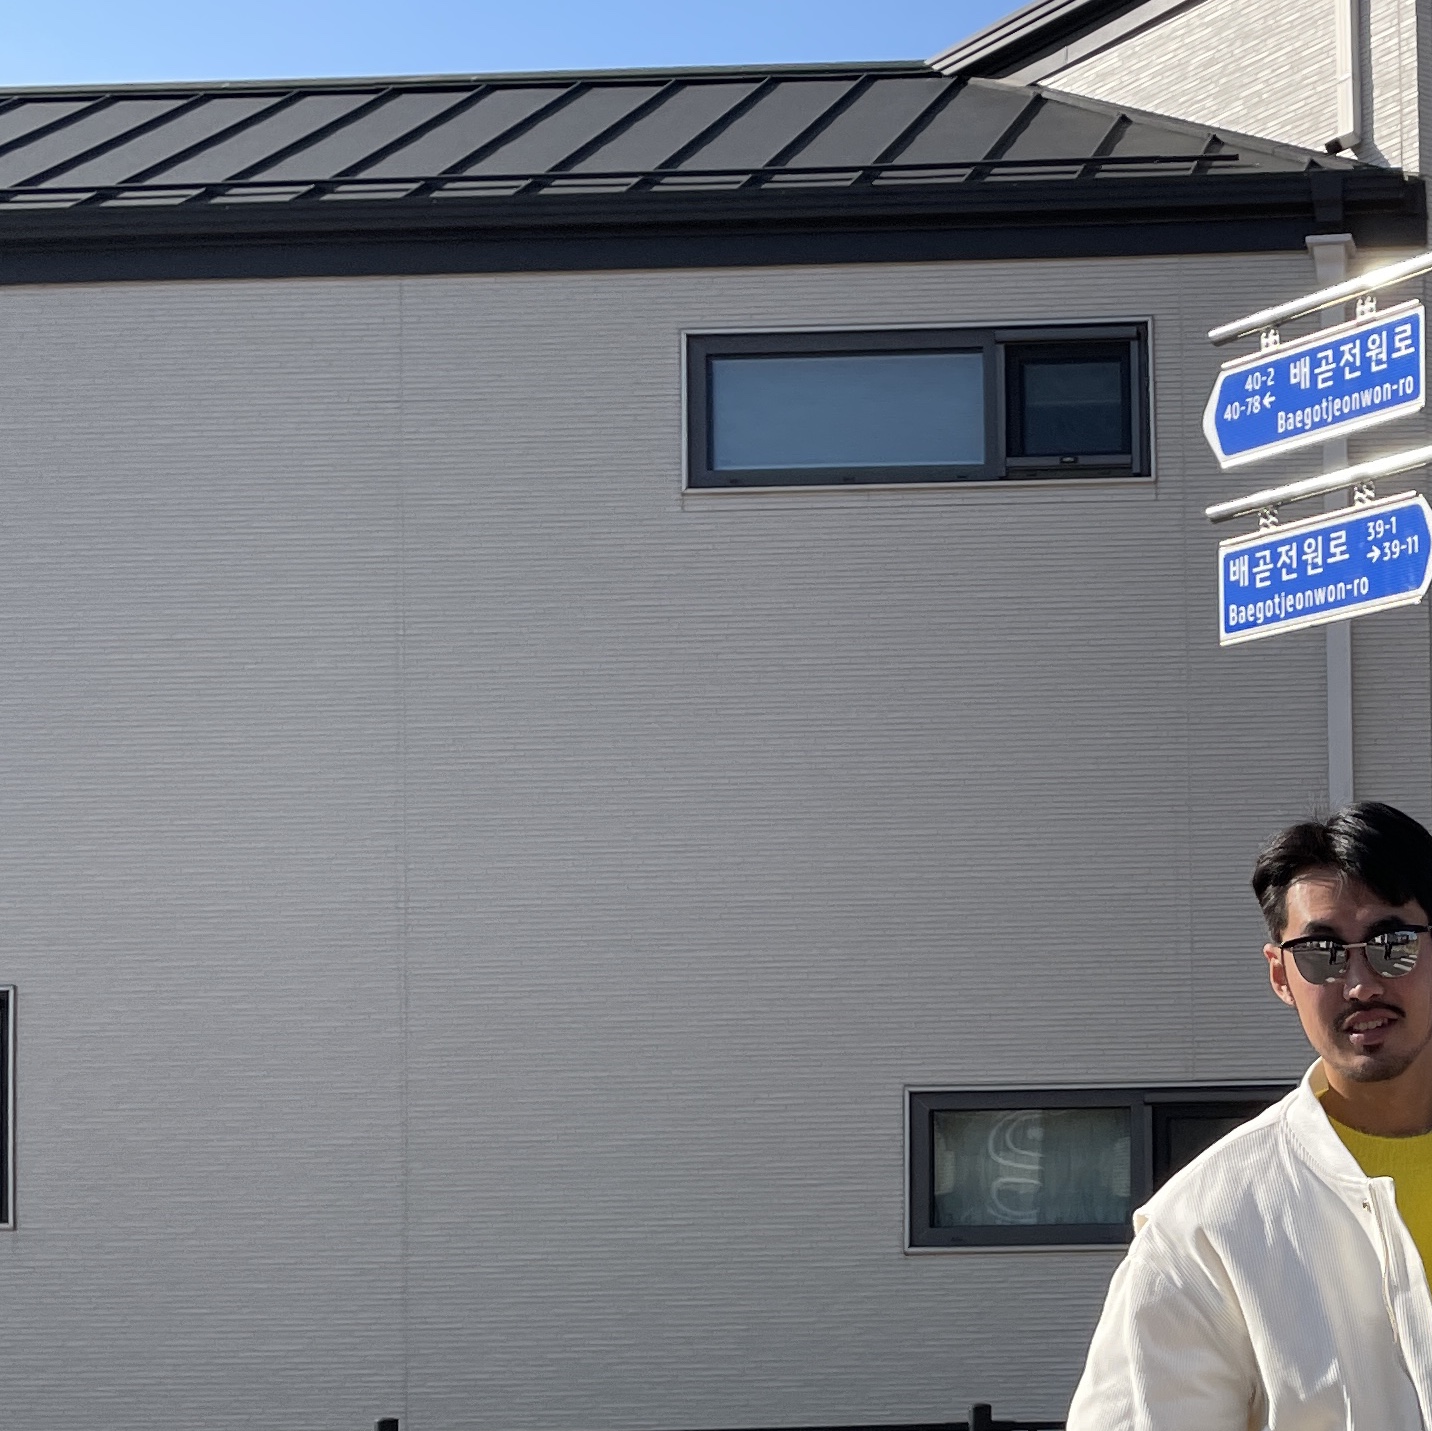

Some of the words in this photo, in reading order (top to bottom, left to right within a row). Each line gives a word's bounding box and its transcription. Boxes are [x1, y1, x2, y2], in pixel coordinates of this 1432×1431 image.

[1289, 322, 1416, 390] 배곧전원로
[1244, 368, 1275, 392] 40-2
[1223, 395, 1262, 421] 40-78
[1277, 375, 1415, 434] Baegotjeonwon-ro
[1366, 516, 1397, 541] 39-1
[1229, 530, 1350, 588] 배곧전원로
[1382, 535, 1419, 561] 39-11
[1228, 576, 1370, 626] Baegotjeonwon-ro
